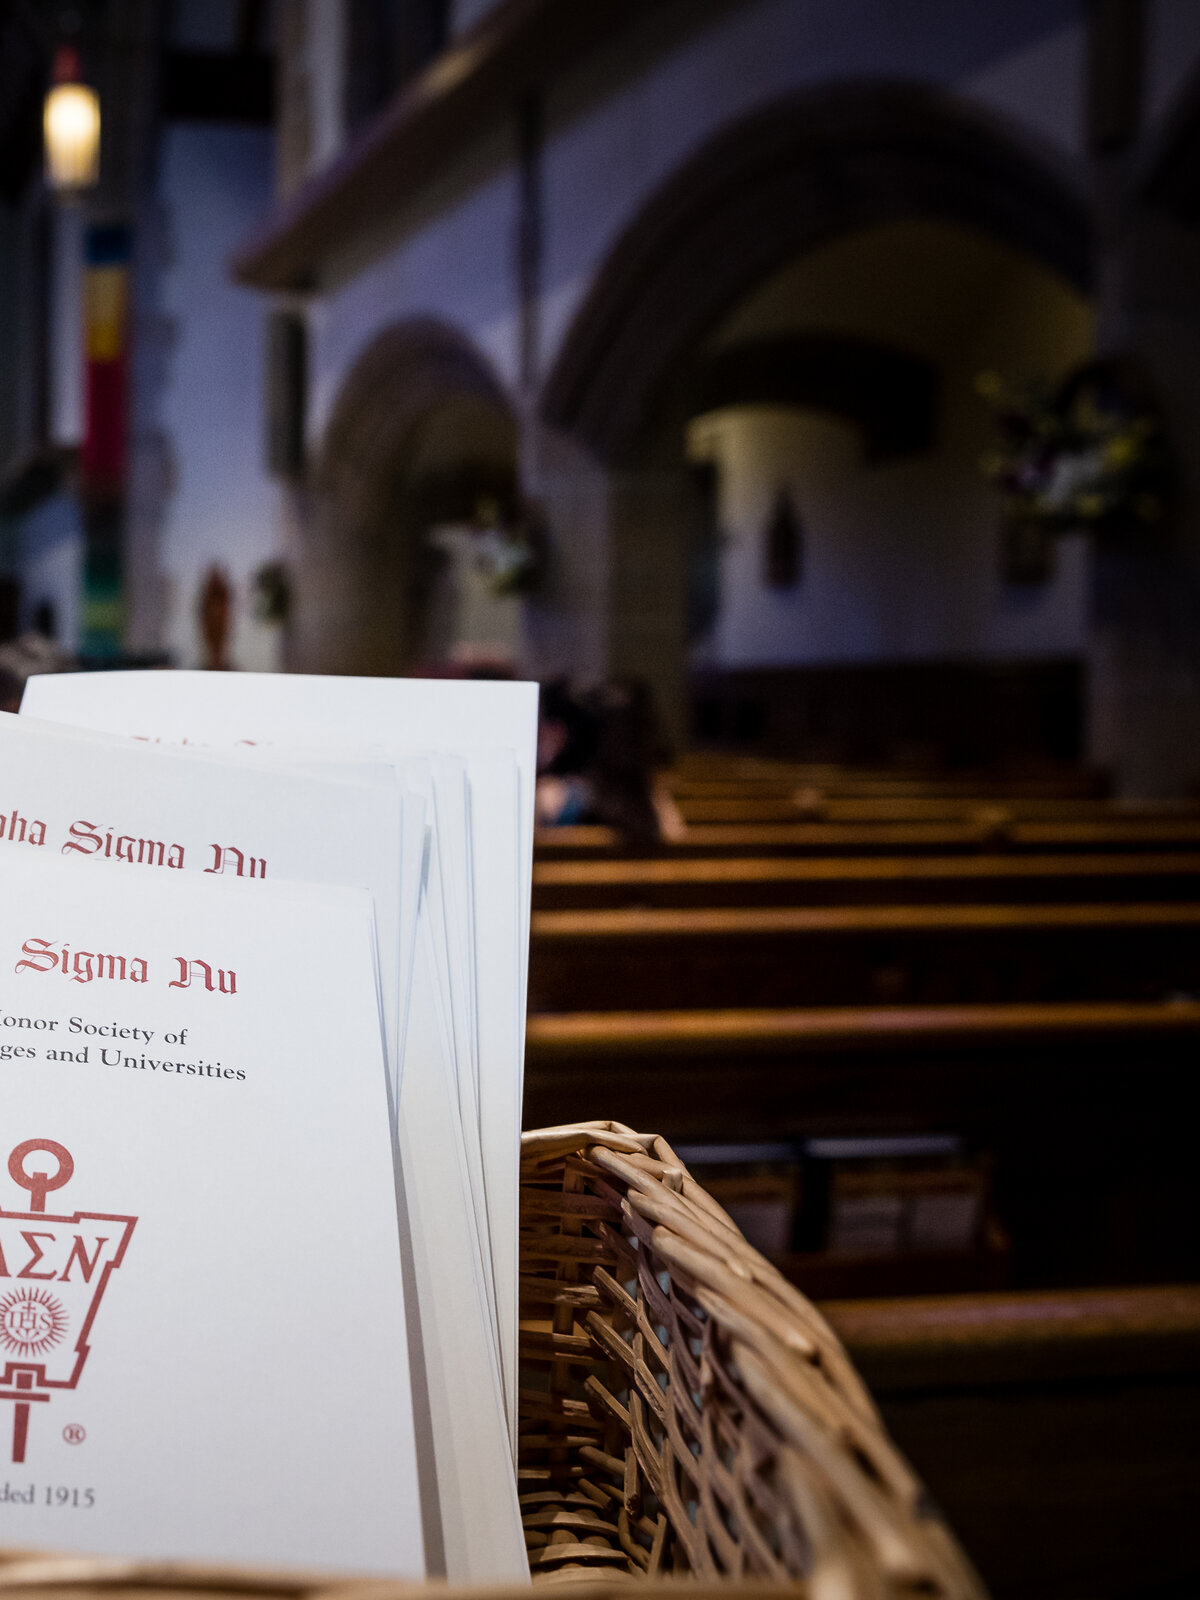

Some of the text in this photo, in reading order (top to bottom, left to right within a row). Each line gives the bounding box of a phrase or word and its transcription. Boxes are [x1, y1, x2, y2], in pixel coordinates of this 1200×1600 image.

[60, 820, 186, 870] Sigma
[202, 843, 268, 880] Nu
[14, 937, 150, 985] Sigma
[168, 956, 239, 996] Nu
[67, 1016, 156, 1046] Society
[163, 1027, 189, 1047] of
[45, 1046, 90, 1065] and
[98, 1047, 248, 1082] Universities
[44, 1485, 96, 1508] 1915
